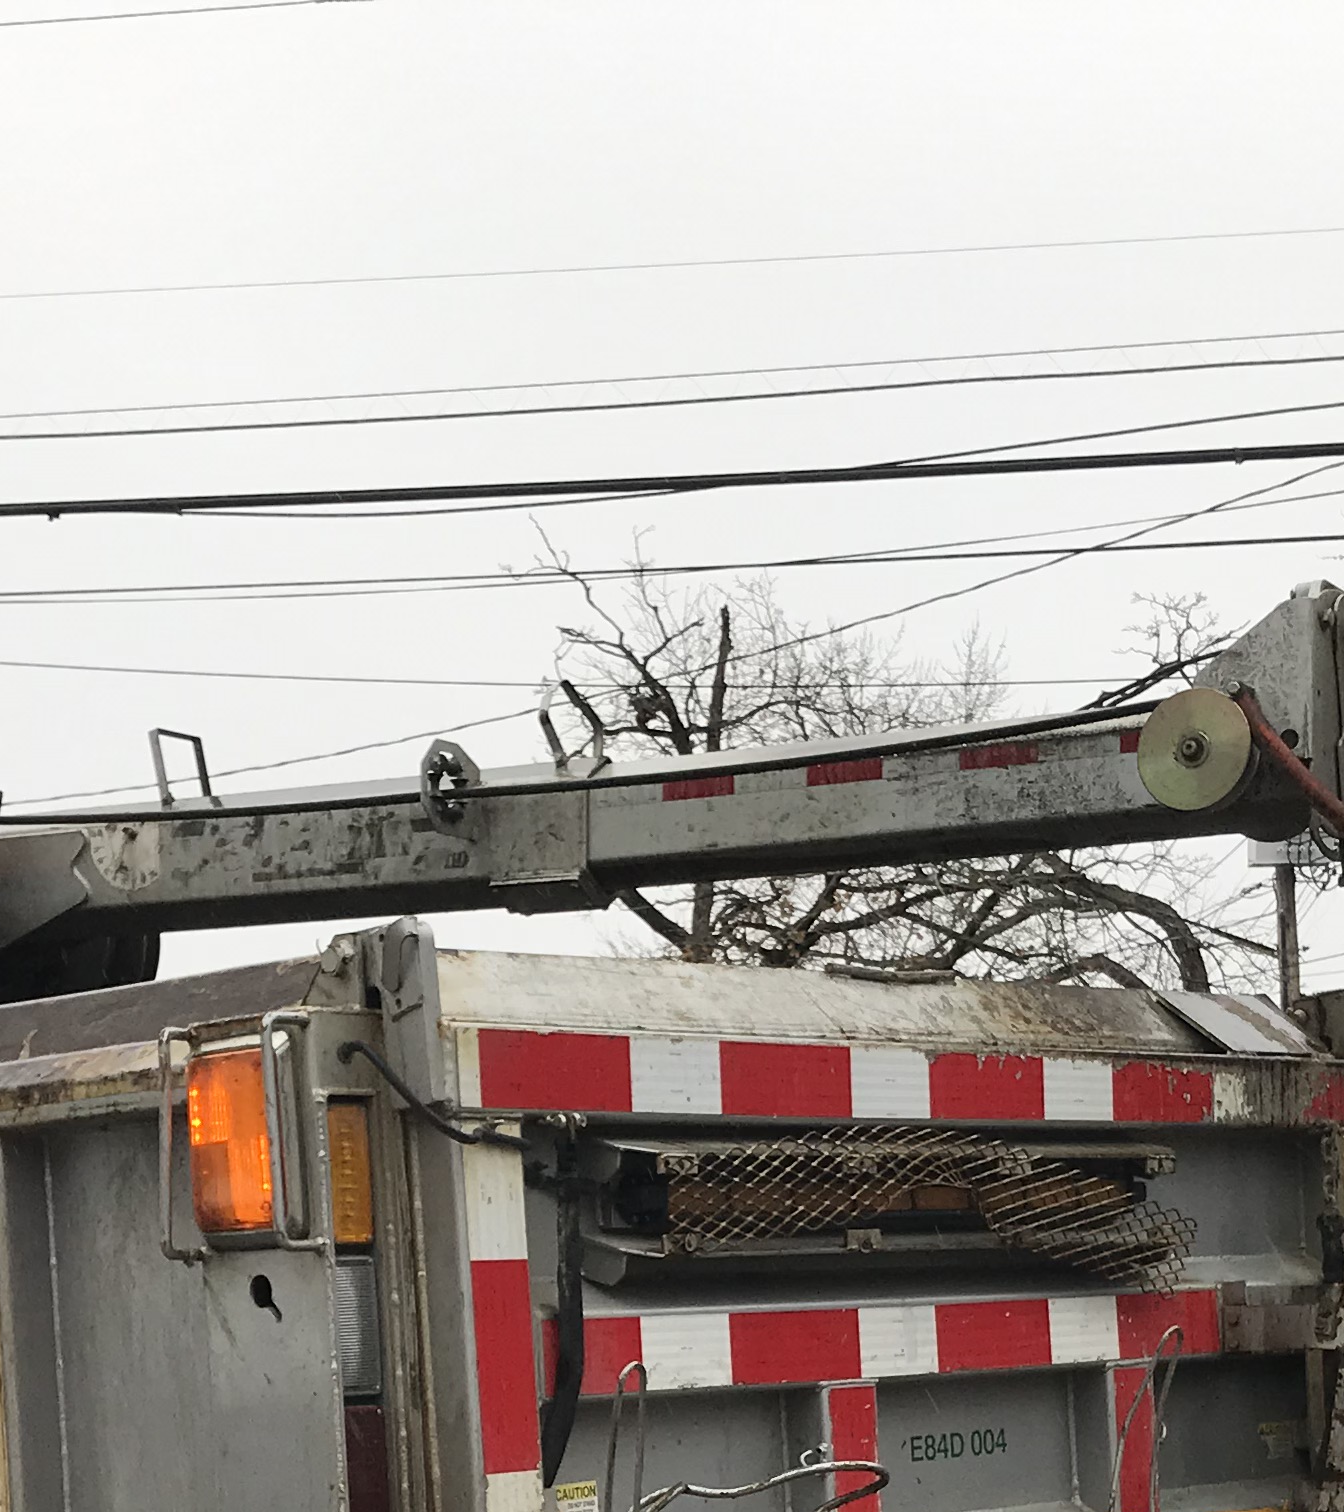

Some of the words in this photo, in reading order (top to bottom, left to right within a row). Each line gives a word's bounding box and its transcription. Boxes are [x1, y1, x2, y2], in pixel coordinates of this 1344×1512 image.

[910, 1433, 964, 1462] E84D
[970, 1428, 1007, 1456] 004
[556, 1485, 596, 1501] CAUTION
